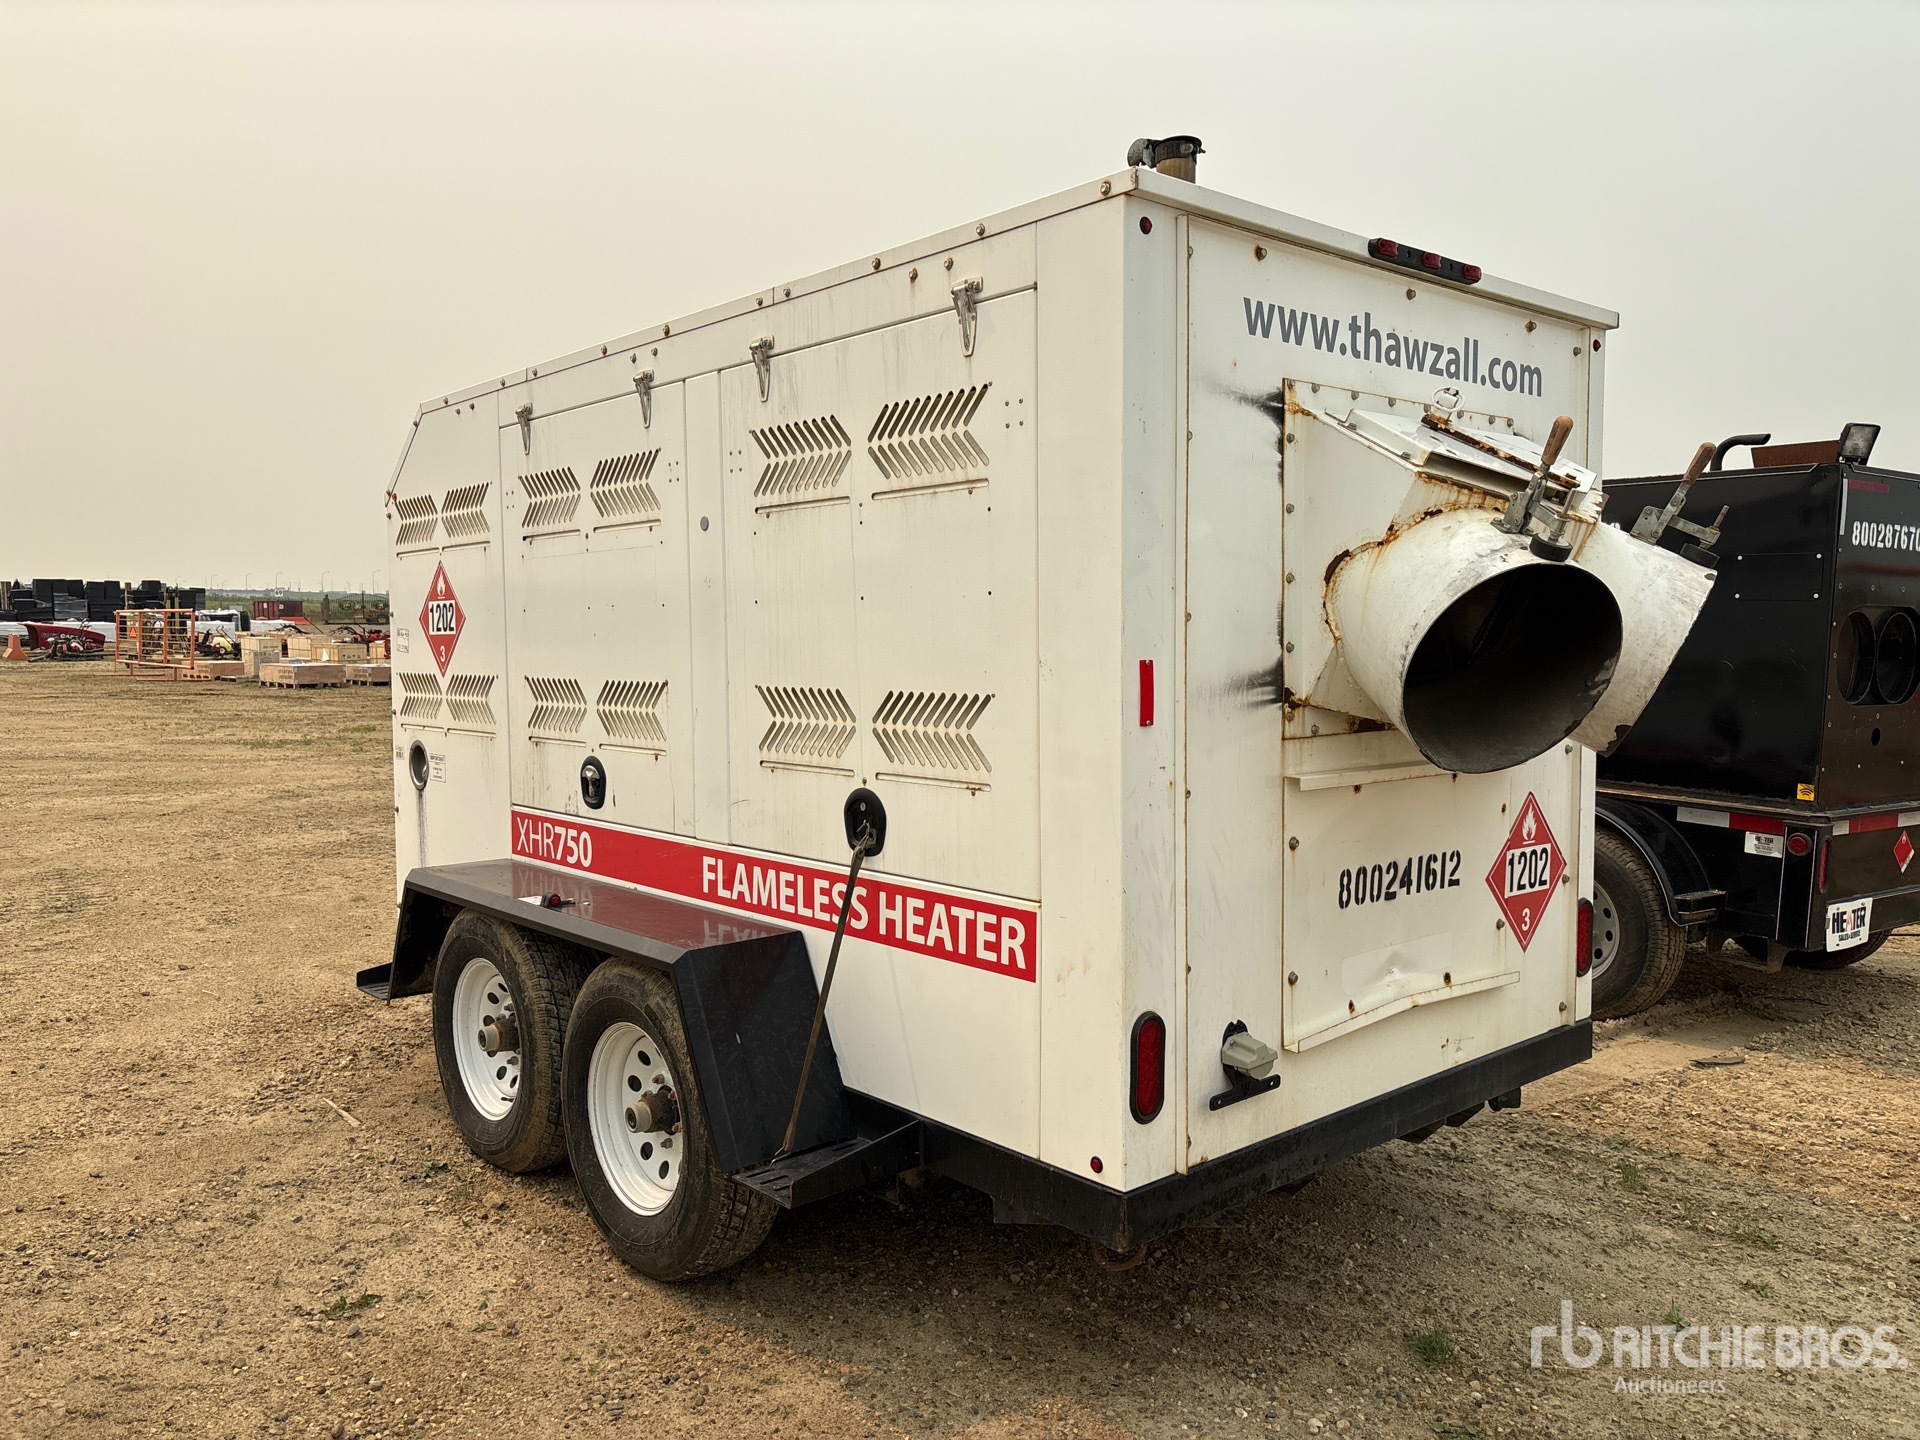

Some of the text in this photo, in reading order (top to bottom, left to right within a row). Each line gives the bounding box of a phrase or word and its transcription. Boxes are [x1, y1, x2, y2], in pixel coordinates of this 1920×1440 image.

[1243, 296, 1543, 398] www.thawzall.com
[430, 602, 455, 633] 1202
[440, 645, 446, 662] 3
[516, 816, 593, 868] XHR750
[1337, 850, 1461, 909] 800241612
[1508, 847, 1548, 893] 1202
[702, 855, 1027, 970] FLAMELESS HEATER
[1521, 907, 1531, 931] 3
[1831, 906, 1866, 934] HEATER
